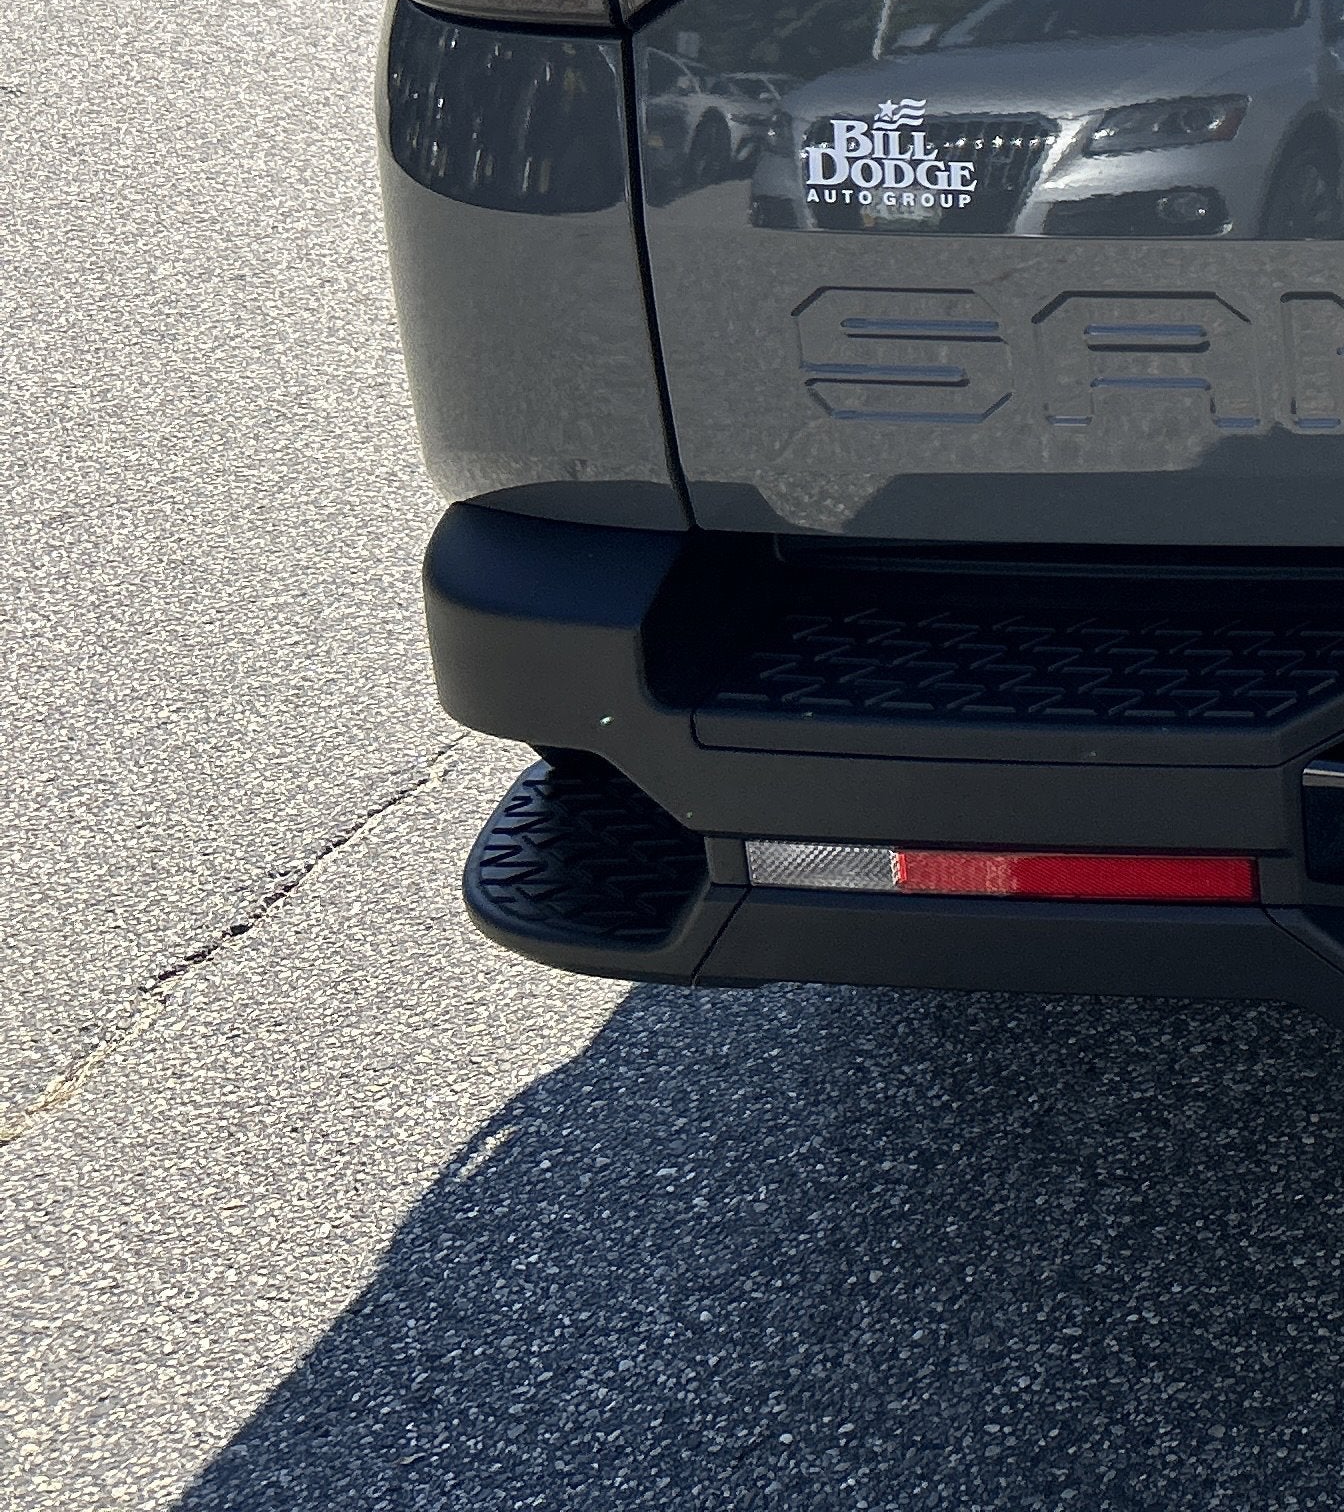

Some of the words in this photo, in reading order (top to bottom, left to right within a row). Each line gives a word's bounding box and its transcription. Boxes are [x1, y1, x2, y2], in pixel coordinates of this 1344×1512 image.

[830, 119, 938, 160] BILL
[804, 147, 978, 192] DODGE
[806, 188, 873, 205] AUTO
[882, 191, 973, 208] GROUP
